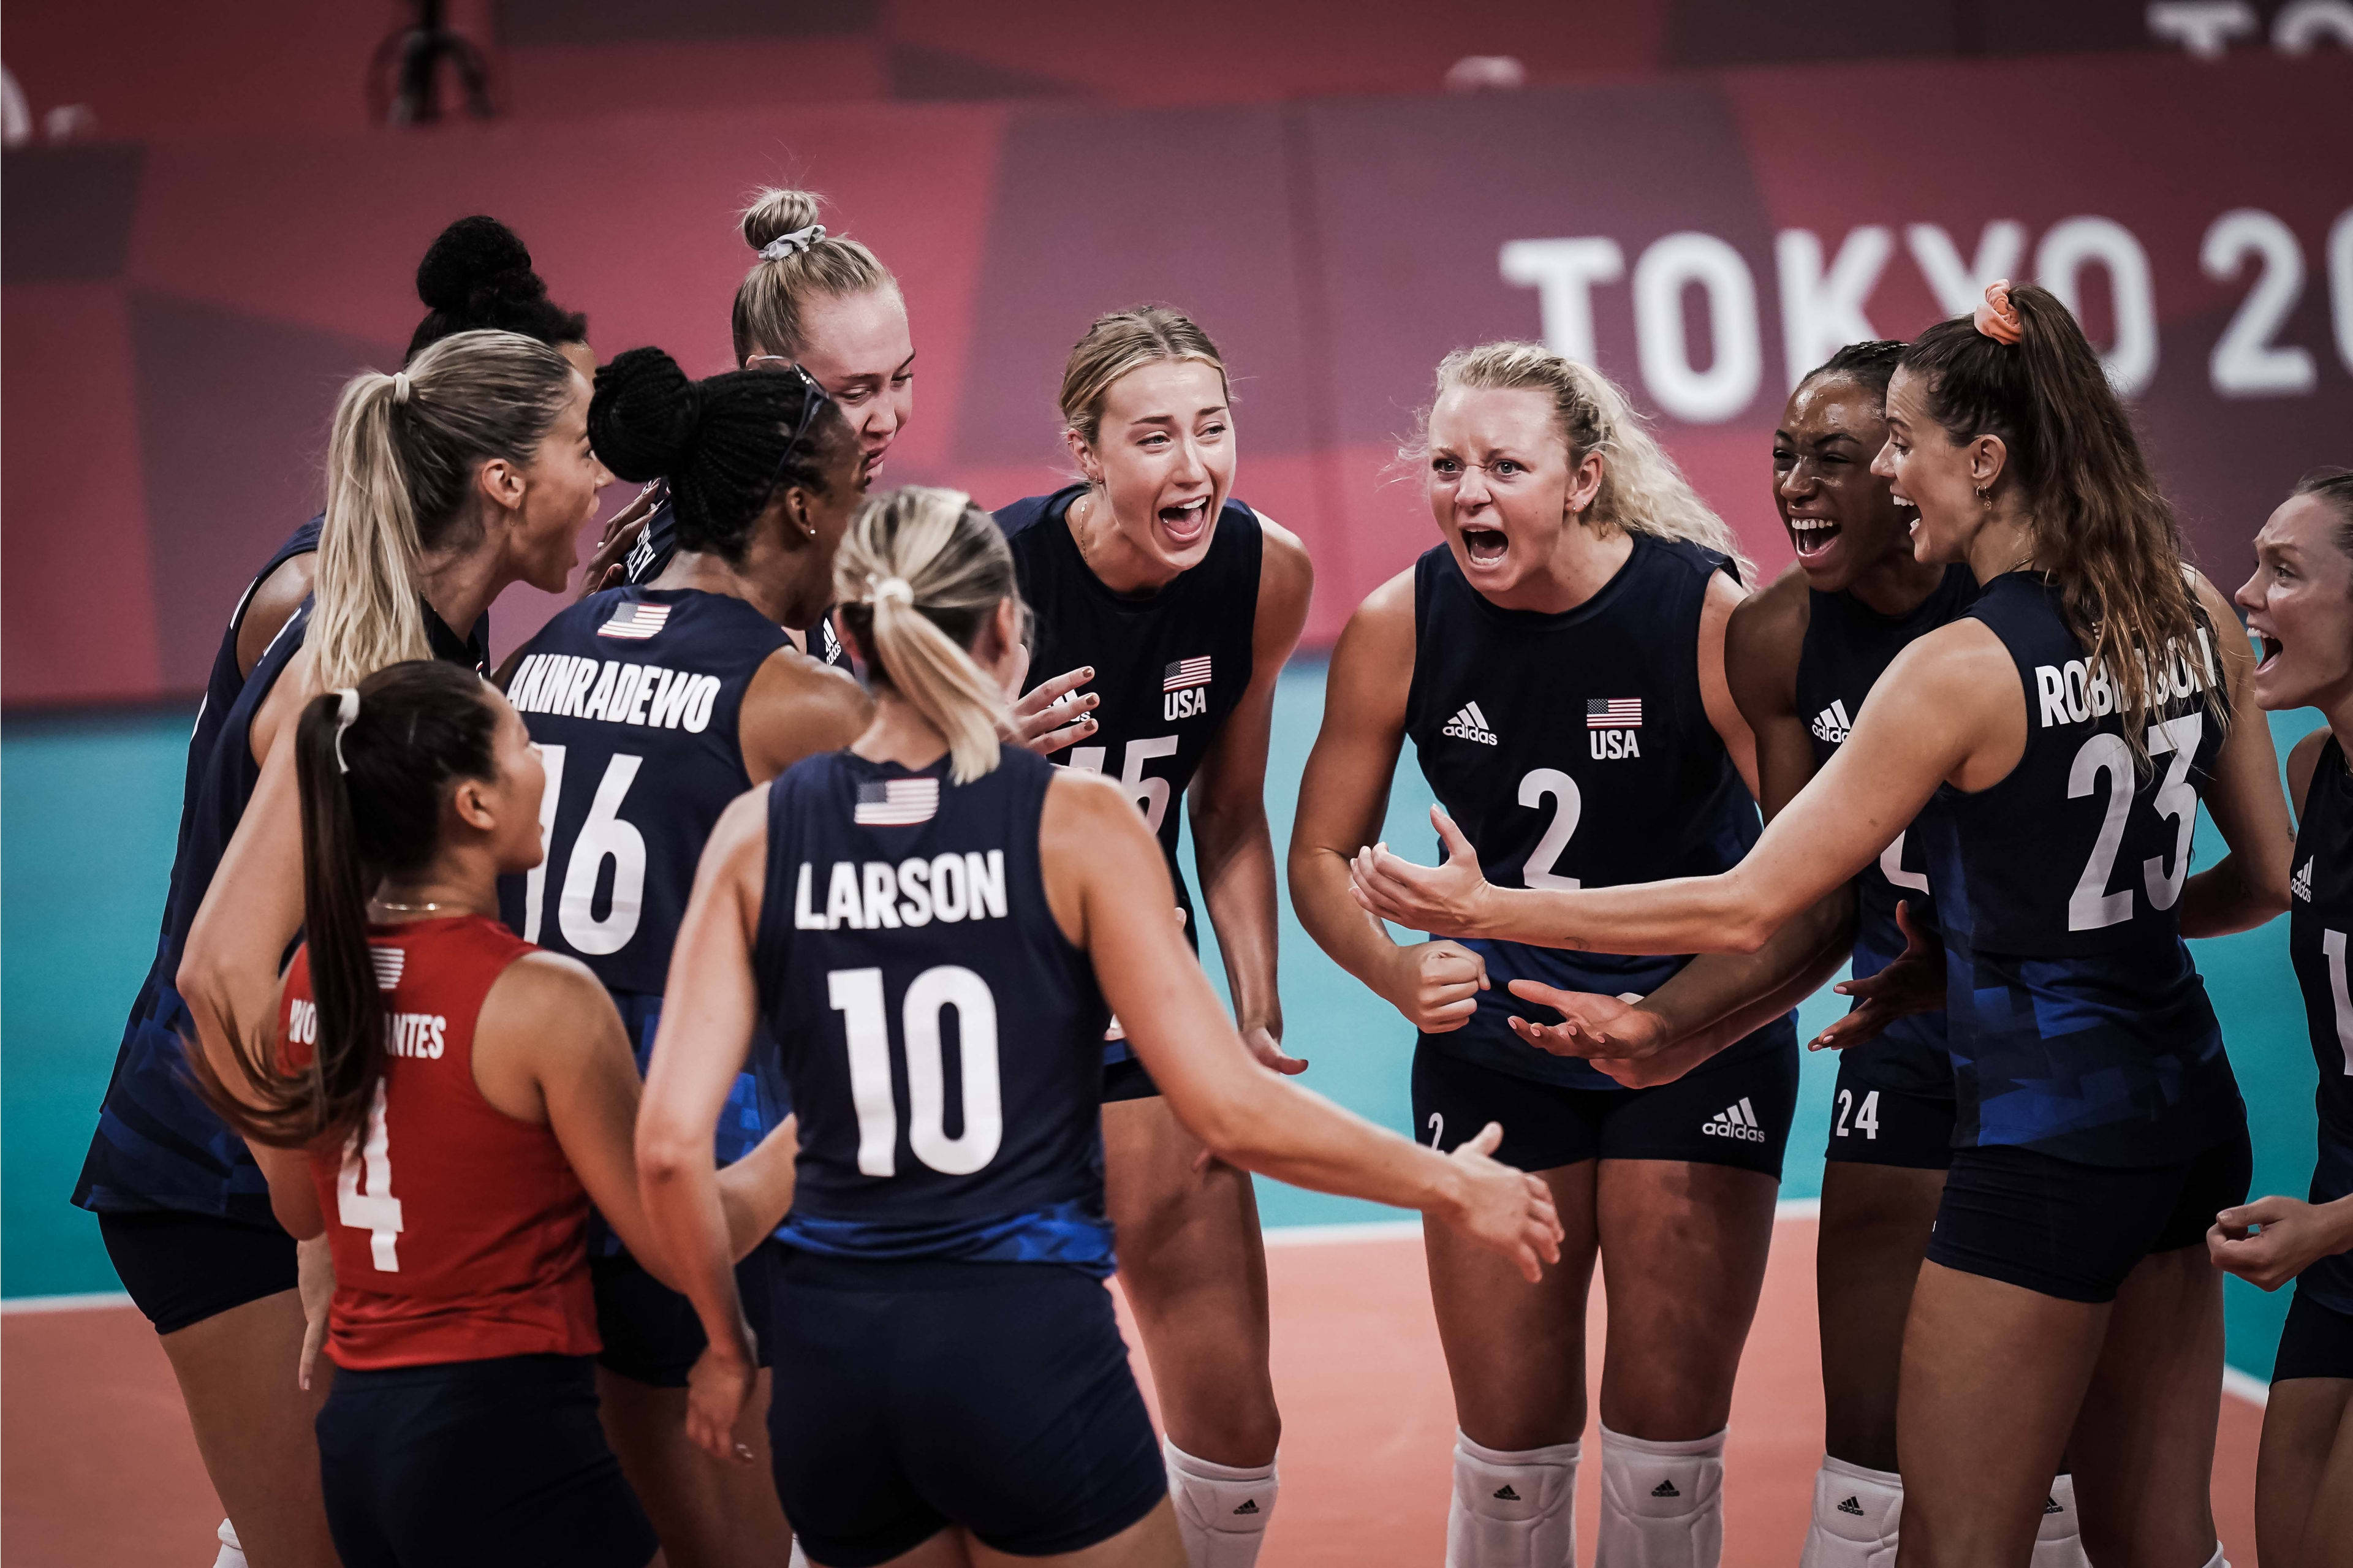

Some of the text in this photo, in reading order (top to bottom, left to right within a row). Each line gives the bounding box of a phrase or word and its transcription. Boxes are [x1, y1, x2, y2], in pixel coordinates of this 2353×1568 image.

[2199, 207, 2353, 400] 2
[506, 653, 721, 733] AKINRADEWO
[1164, 687, 1207, 722] USA
[1442, 723, 1498, 746] adidas
[1590, 729, 1640, 760] USA
[524, 743, 647, 955] 16
[1518, 768, 1582, 890] 2
[2067, 712, 2203, 932] 23
[794, 849, 1008, 930] LARSON
[2290, 877, 2312, 903] adidas
[827, 964, 1003, 1177] 10
[1702, 1121, 1765, 1143] adidas
[1836, 1089, 1879, 1140] 24
[336, 1076, 404, 1273] 4
